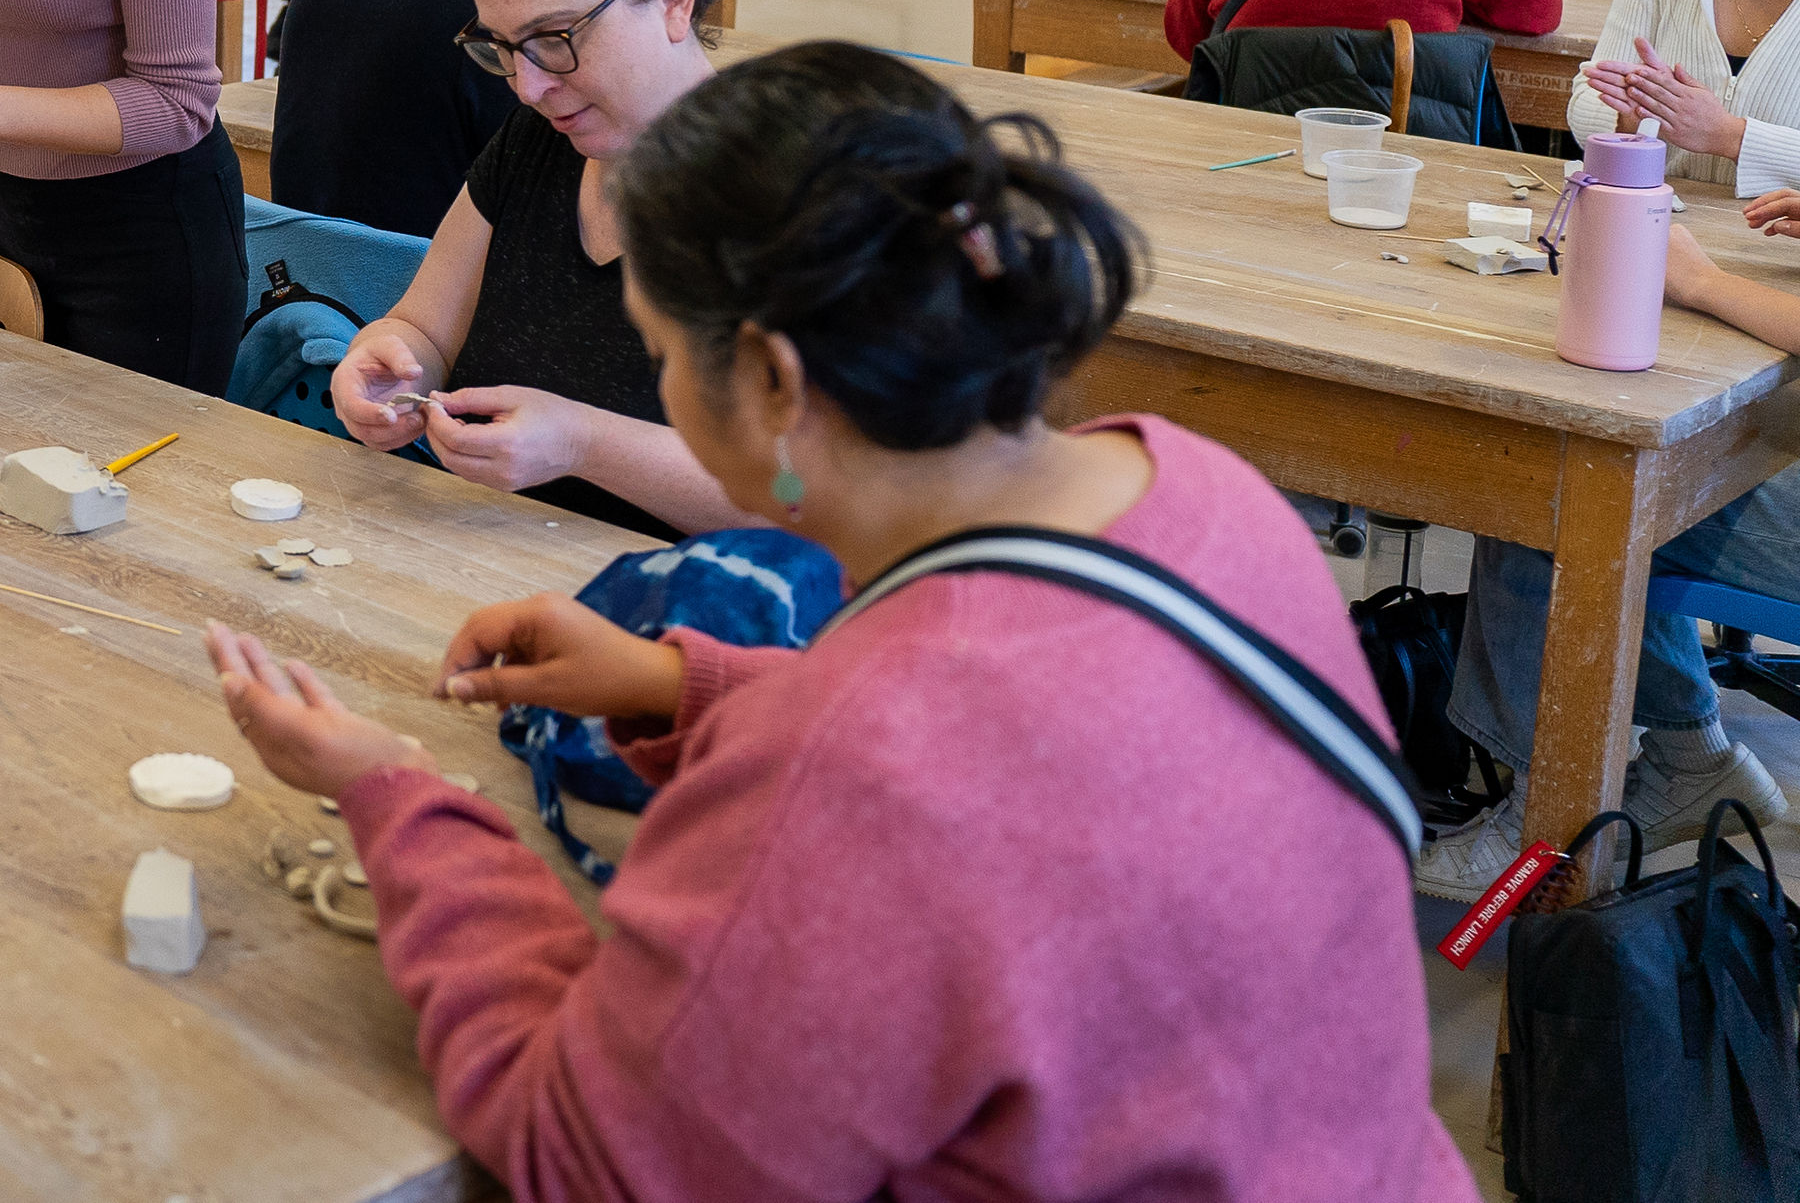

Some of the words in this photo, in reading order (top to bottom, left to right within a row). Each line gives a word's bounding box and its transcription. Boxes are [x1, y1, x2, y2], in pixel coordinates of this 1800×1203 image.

[1504, 858, 1540, 893] REMOVE
[1478, 890, 1509, 924] BEFORE
[1450, 920, 1484, 957] LAUNCH
